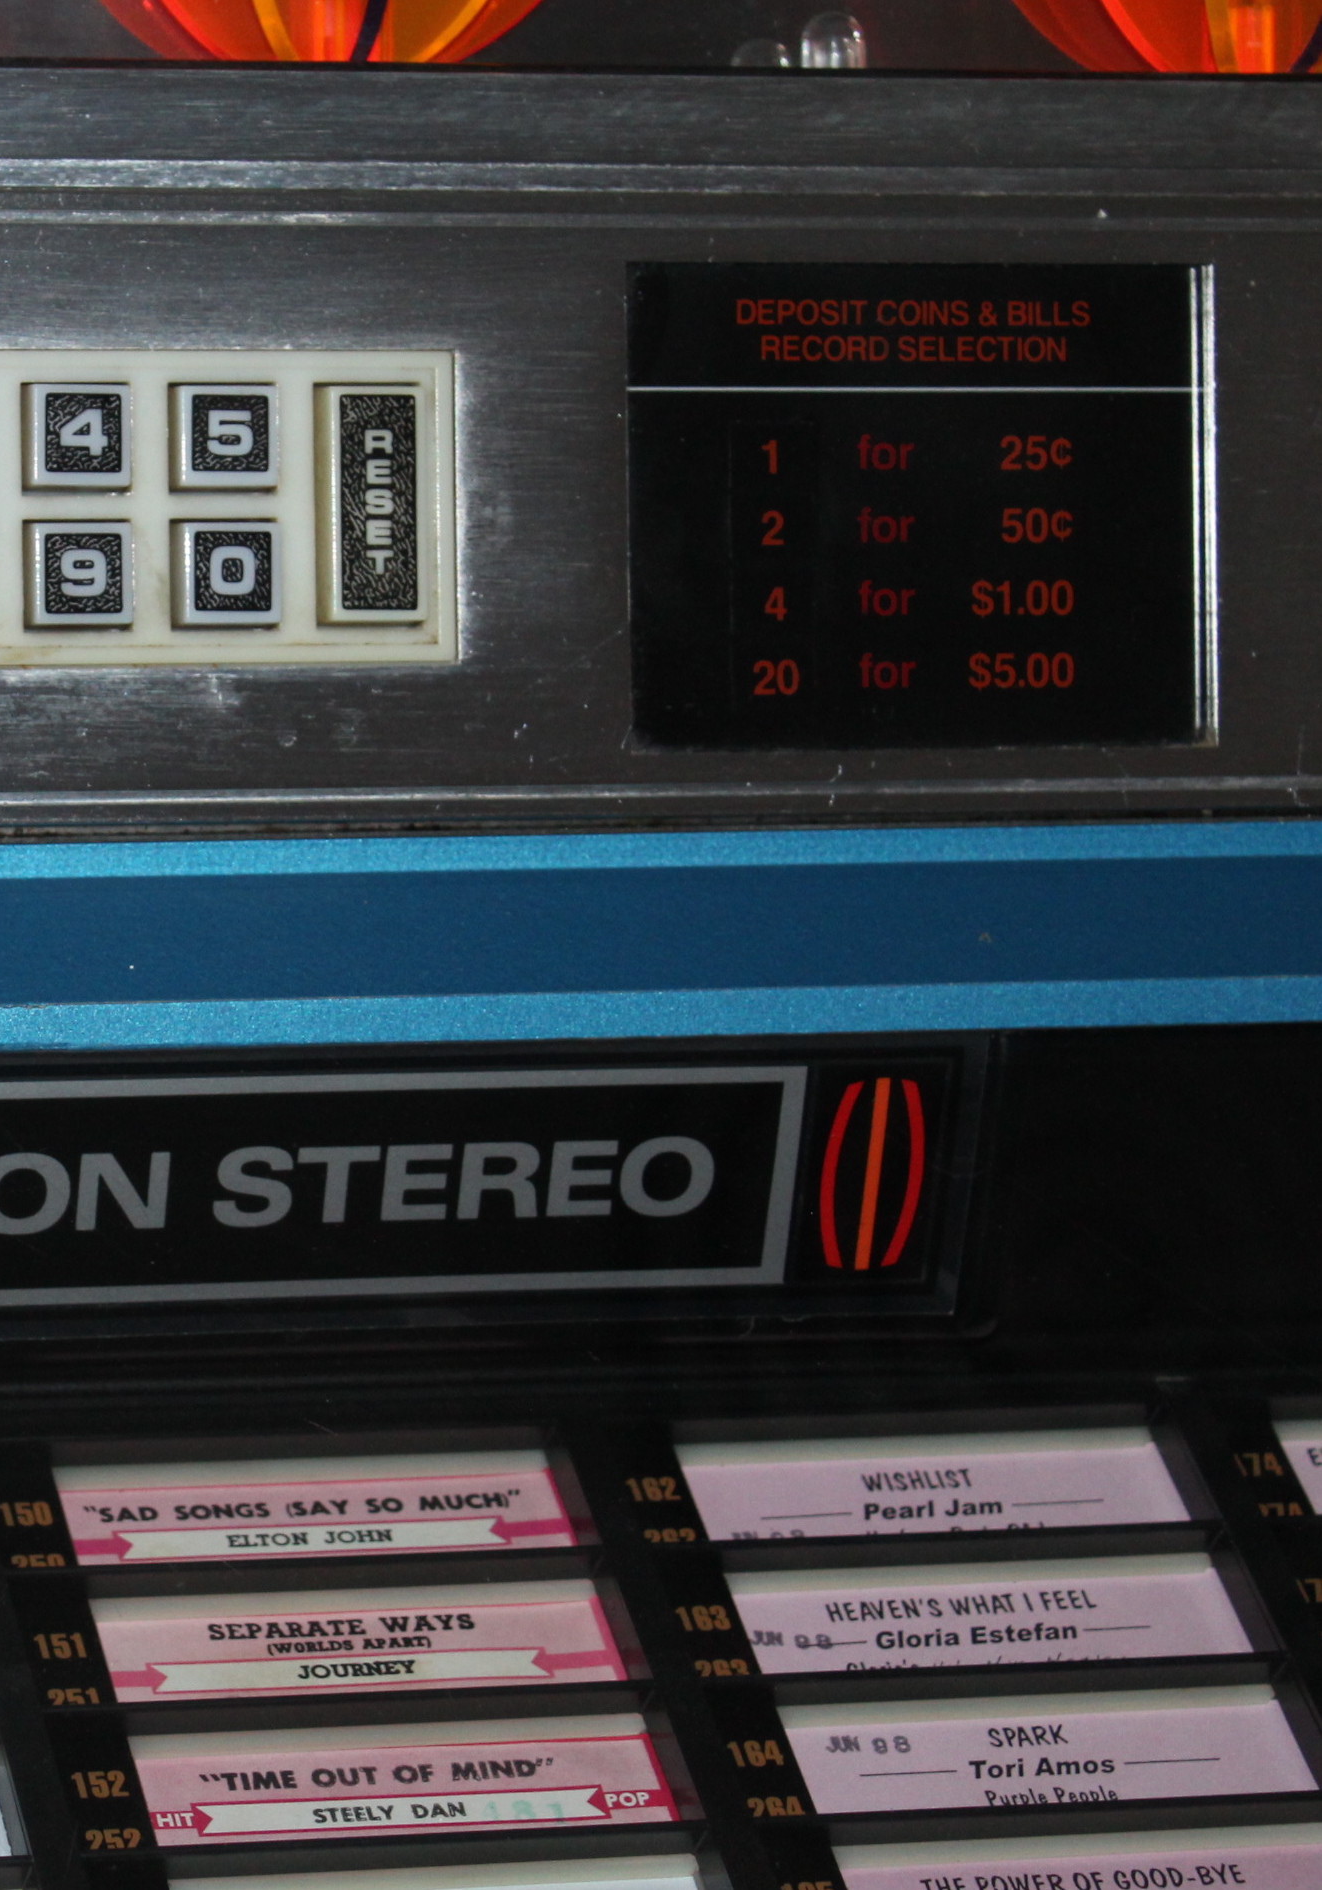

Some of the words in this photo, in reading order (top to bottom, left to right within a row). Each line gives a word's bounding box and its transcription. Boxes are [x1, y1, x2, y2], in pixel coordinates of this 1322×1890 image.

[735, 299, 868, 326] DEPOSIT
[877, 300, 969, 326] COINS
[979, 301, 998, 326] &
[1007, 301, 1091, 327] BILLS
[761, 336, 889, 361] RECORD
[897, 336, 1067, 362] SELECTION
[59, 408, 108, 457] 4
[207, 409, 254, 457] 5
[761, 440, 778, 474] 1
[857, 434, 914, 470] for
[363, 428, 395, 575] RESET
[761, 511, 785, 545] 2
[857, 507, 915, 543] for
[60, 547, 108, 598] 9
[209, 545, 256, 596] 0
[764, 586, 788, 620] 4
[858, 580, 915, 616] for
[971, 580, 1075, 617] $1.00
[752, 659, 800, 695] 20
[859, 652, 916, 689] for
[968, 652, 1075, 690] $5.00
[212, 1136, 716, 1228] STEREO
[626, 1476, 681, 1502] 162
[862, 1468, 972, 1492] WISHLIST
[174, 1502, 271, 1522] SONGS
[286, 1498, 349, 1518] (SAY
[366, 1496, 404, 1514] SO
[863, 1500, 935, 1520] Pearl
[945, 1499, 1003, 1517] Jam
[226, 1532, 309, 1549] ELTON
[325, 1529, 393, 1545] JOHN
[676, 1605, 732, 1632] 163
[825, 1598, 943, 1622] HEAVEN'S
[948, 1593, 1016, 1616] WHAT
[1023, 1593, 1034, 1612] I
[1039, 1589, 1097, 1611] FEEL
[208, 1619, 366, 1641] SEPARATE
[379, 1613, 475, 1633] WAYS
[751, 1630, 784, 1647] JUN
[875, 1628, 960, 1650] Gloria
[970, 1623, 1078, 1645] Estefan
[33, 1633, 87, 1659] 151
[267, 1639, 354, 1656] (WORLDS
[363, 1636, 432, 1651] APART)
[298, 1660, 416, 1680] JOURNEY
[826, 1735, 861, 1753] JUN
[987, 1724, 1069, 1748] SPARK
[726, 1739, 785, 1768] 164
[311, 1766, 377, 1788] OUT
[392, 1763, 434, 1784] OF
[968, 1758, 1025, 1779] Tori
[1035, 1756, 1116, 1776] Amos
[71, 1770, 130, 1799] 152
[312, 1804, 394, 1824] STEELY
[411, 1801, 467, 1820] DAN
[604, 1792, 650, 1808] POP
[156, 1812, 195, 1828] HIT
[1072, 1871, 1103, 1890] OF
[1113, 1863, 1246, 1890] GOOD-BYE
